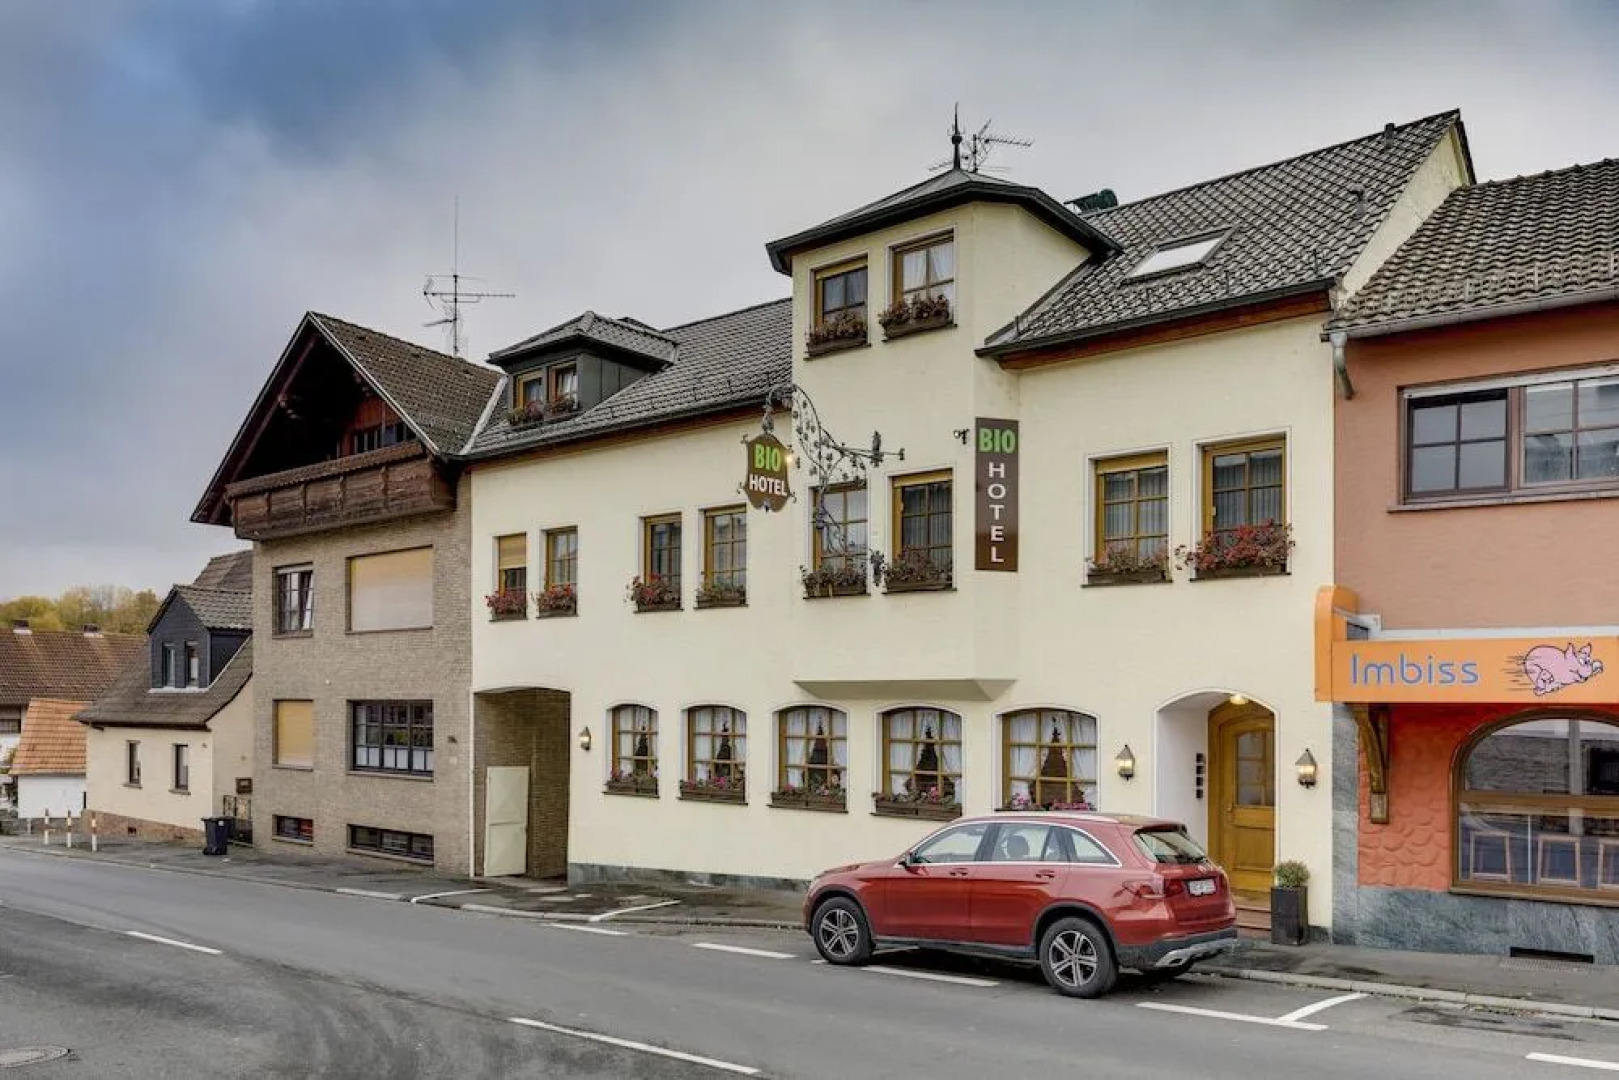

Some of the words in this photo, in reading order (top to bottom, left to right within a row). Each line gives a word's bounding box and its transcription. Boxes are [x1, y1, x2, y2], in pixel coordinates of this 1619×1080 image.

[979, 428, 1016, 453] BIO
[754, 443, 781, 472] BIO
[749, 473, 788, 497] HOTEL
[987, 462, 1007, 563] HOTEL
[1351, 654, 1480, 685] Imbiss
